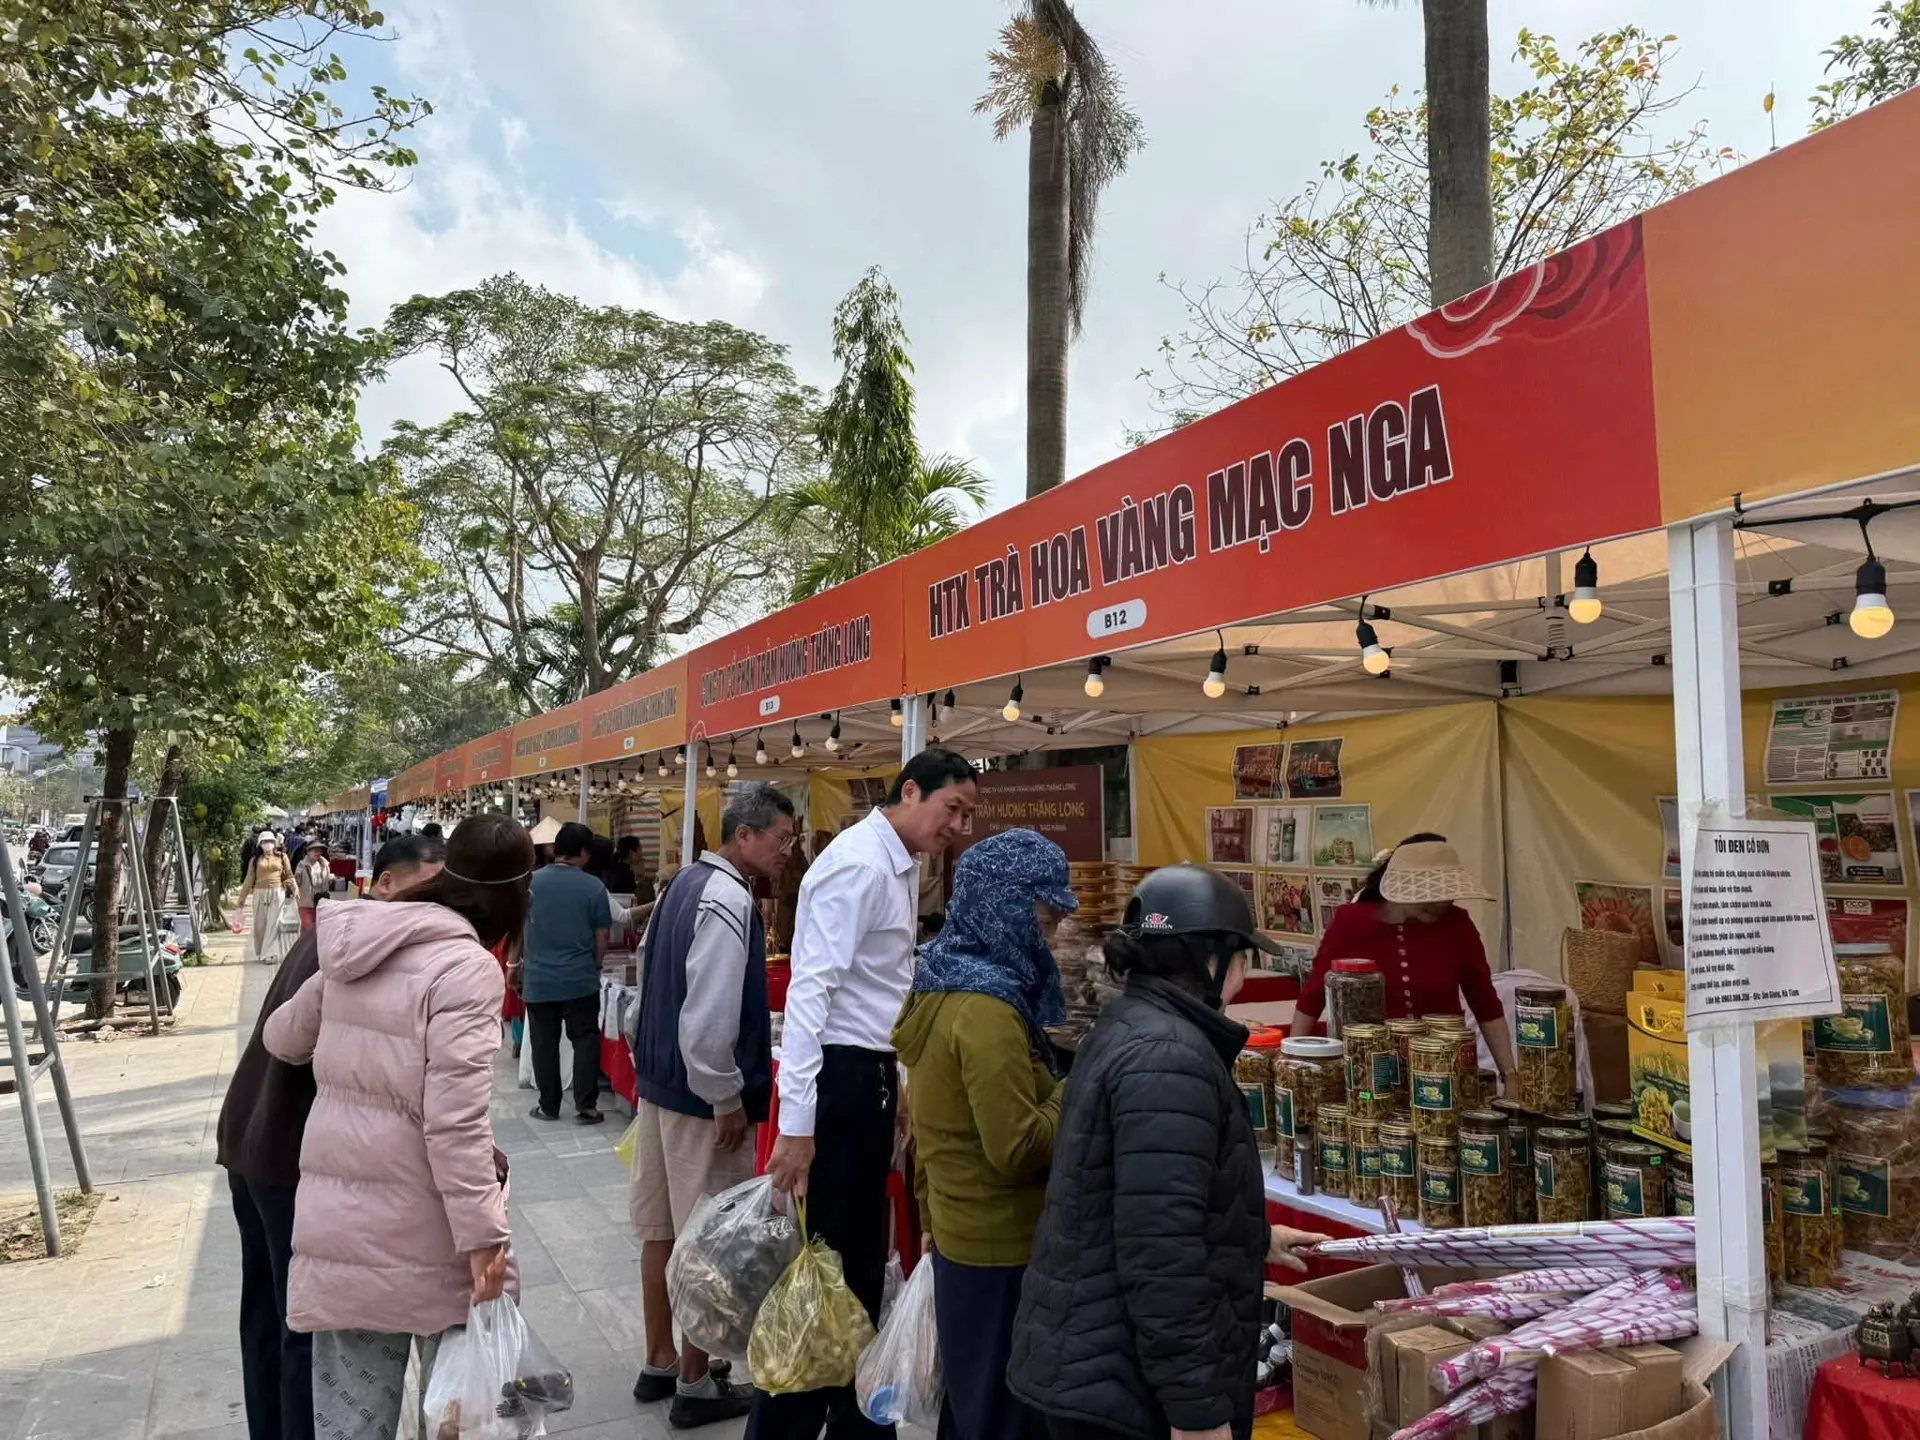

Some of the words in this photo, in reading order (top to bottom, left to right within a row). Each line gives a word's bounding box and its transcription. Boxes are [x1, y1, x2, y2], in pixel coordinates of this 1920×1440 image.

[929, 566, 970, 641] HTX
[975, 546, 1024, 624] TRÀ
[1029, 526, 1091, 608] HOA
[1097, 484, 1197, 587] VÀNG
[1207, 438, 1313, 554] MẠC
[1327, 383, 1454, 516] NGA
[1104, 609, 1128, 629] B12
[810, 621, 841, 675] THĂNG
[843, 613, 870, 666] LONG
[975, 799, 995, 818] TRẦM
[997, 800, 1026, 818] HƯƠNG
[1028, 800, 1056, 818] THĂNG
[1059, 801, 1085, 817] LONG
[1714, 834, 1726, 853] TỎI
[1141, 921, 1174, 930] FASHION
